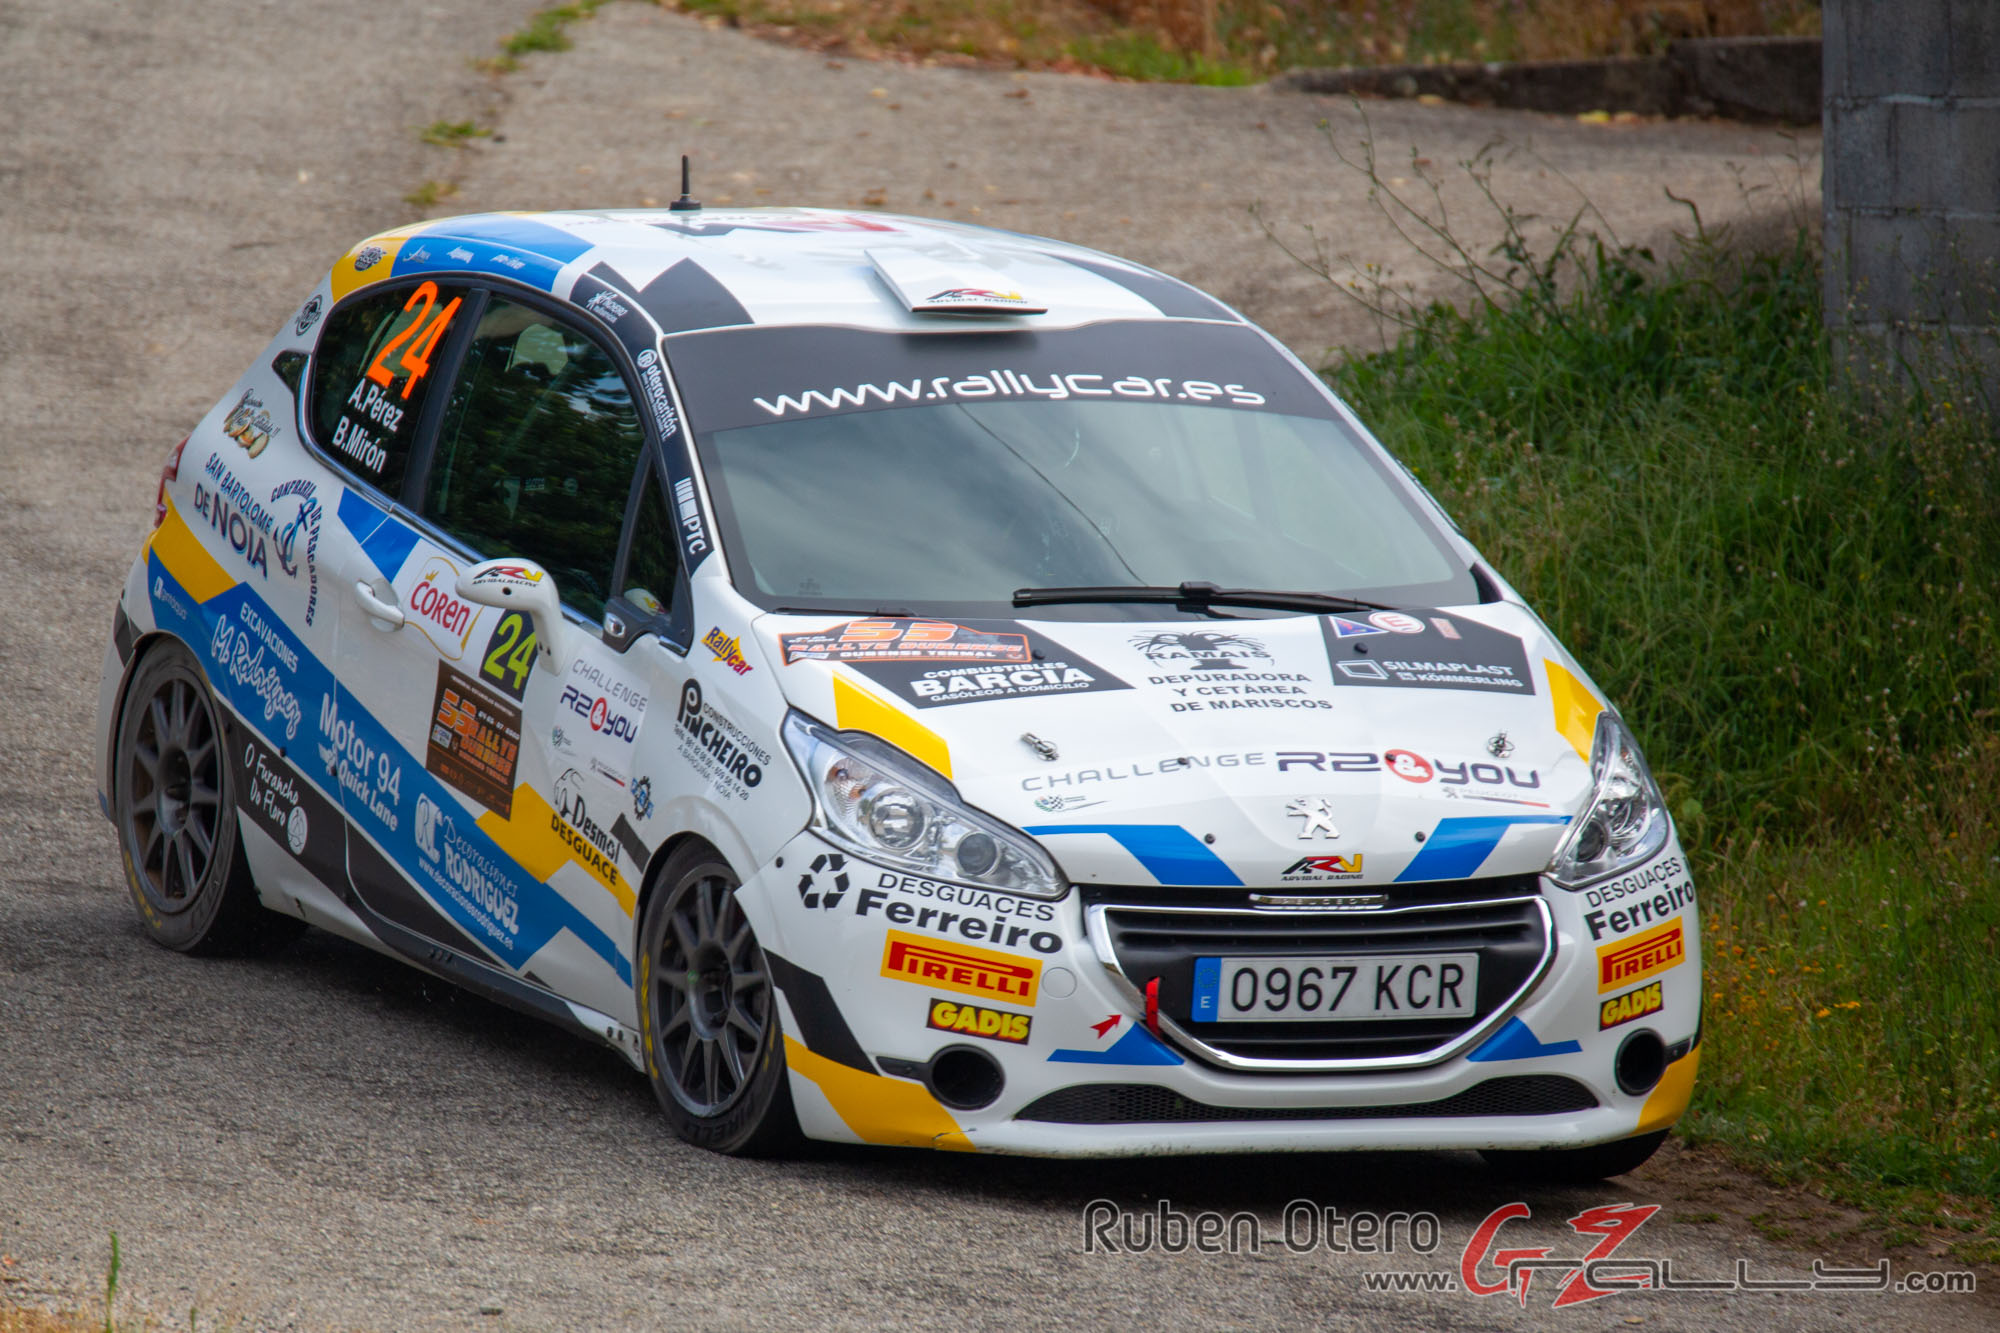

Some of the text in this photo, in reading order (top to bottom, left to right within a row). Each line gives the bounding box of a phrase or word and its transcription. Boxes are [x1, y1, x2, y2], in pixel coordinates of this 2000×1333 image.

[367, 281, 462, 400] 24
[347, 377, 404, 432] A.Pérez
[753, 369, 1266, 417] www.rallycar.es
[331, 415, 387, 473] B.Mirón
[206, 452, 226, 481] SAN
[221, 471, 275, 535] BARTOLOME
[194, 482, 269, 581] DE NOIA
[271, 479, 323, 628] CONFRARIA DE PESCADORES
[682, 515, 707, 555] PTC
[240, 601, 299, 673] EXCAVACIONES
[483, 613, 538, 690] 24
[788, 642, 1023, 652] RALLYE OURENSE
[838, 621, 959, 642] 53
[1145, 651, 1272, 660] RAMAIS
[571, 659, 648, 712] CHALLENGE
[910, 668, 1096, 697] BARCIA
[923, 662, 1068, 680] COMBUSTIBLES
[930, 688, 1005, 702] GASÓLEOS
[1018, 682, 1090, 693] DOMICILIO
[1148, 673, 1312, 685] DEPURADORA
[1173, 683, 1308, 697] Y CETÁREA
[1382, 661, 1515, 676] SILMAPLAST
[437, 687, 478, 737] 53
[1170, 699, 1333, 713] DE MARISCOS
[319, 692, 401, 806] Motor 94
[677, 678, 762, 788] PINCHEIRO
[702, 702, 772, 767] CONSTRUCCIONES
[256, 753, 299, 805] Furancho
[337, 759, 398, 832] Quick Lane
[1021, 752, 1266, 792] CHALLENGE
[250, 777, 286, 827] Do Floro
[444, 815, 518, 898] Decoraciones
[551, 814, 618, 886] DESGUACE
[444, 842, 520, 935] RODRIGUEZ
[877, 872, 1055, 922] DESGUACES
[1585, 856, 1682, 908] DESGUACES
[855, 888, 1063, 954] Ferreiro
[1584, 880, 1694, 941] Ferreiro
[887, 940, 1034, 997] PIRELLI
[1602, 927, 1683, 985] PIRELLI
[1200, 995, 1212, 1009] E
[1231, 962, 1465, 1012] 0967 KCR
[1601, 981, 1662, 1025] GADIS
[931, 1002, 1030, 1042] GADIS
